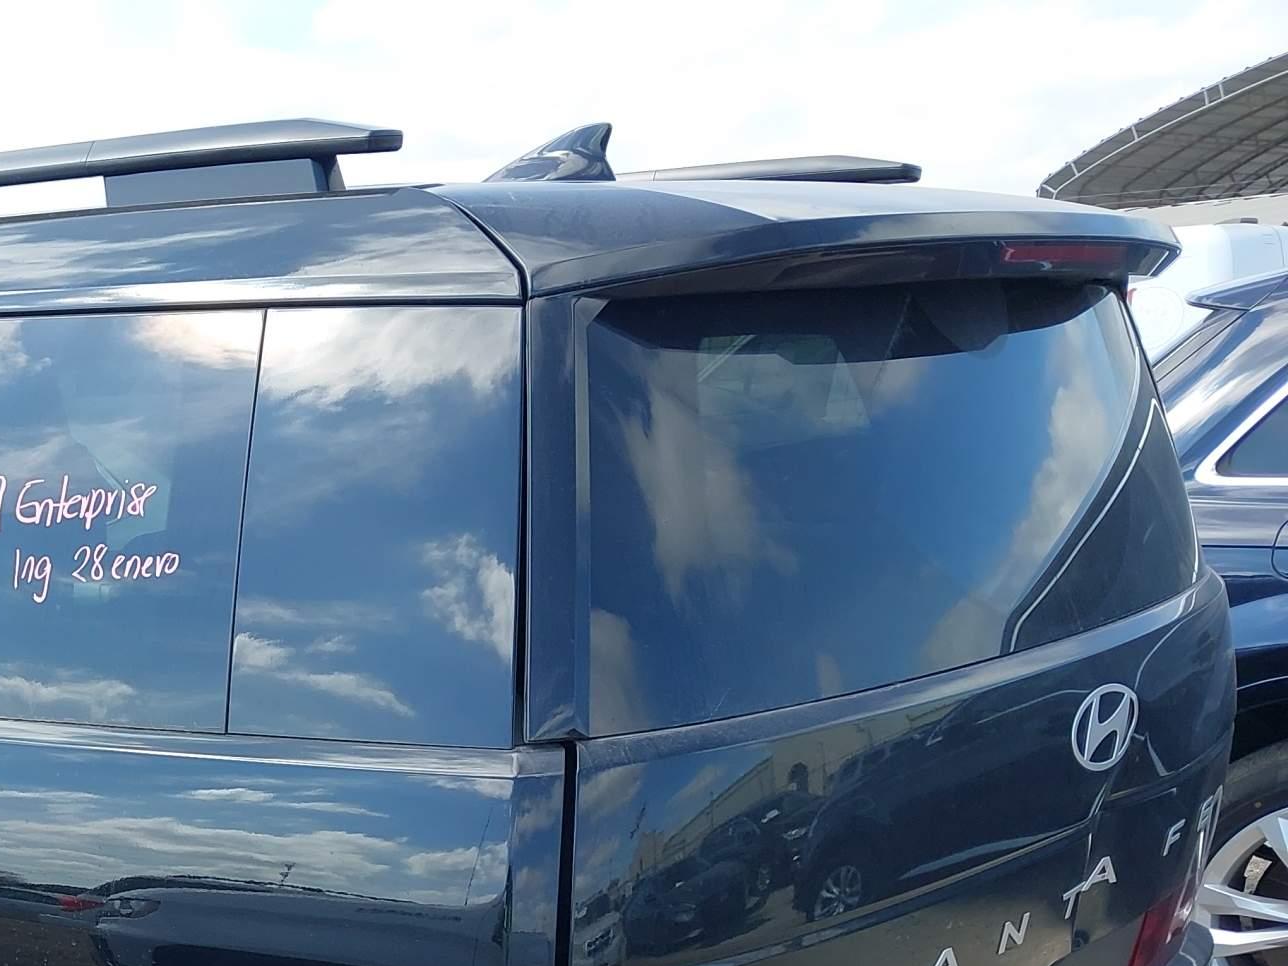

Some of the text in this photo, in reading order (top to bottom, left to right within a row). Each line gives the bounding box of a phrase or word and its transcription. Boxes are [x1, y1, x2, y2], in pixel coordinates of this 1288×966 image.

[72, 543, 108, 582] 28
[111, 552, 180, 580] enero
[1162, 795, 1214, 857] FE
